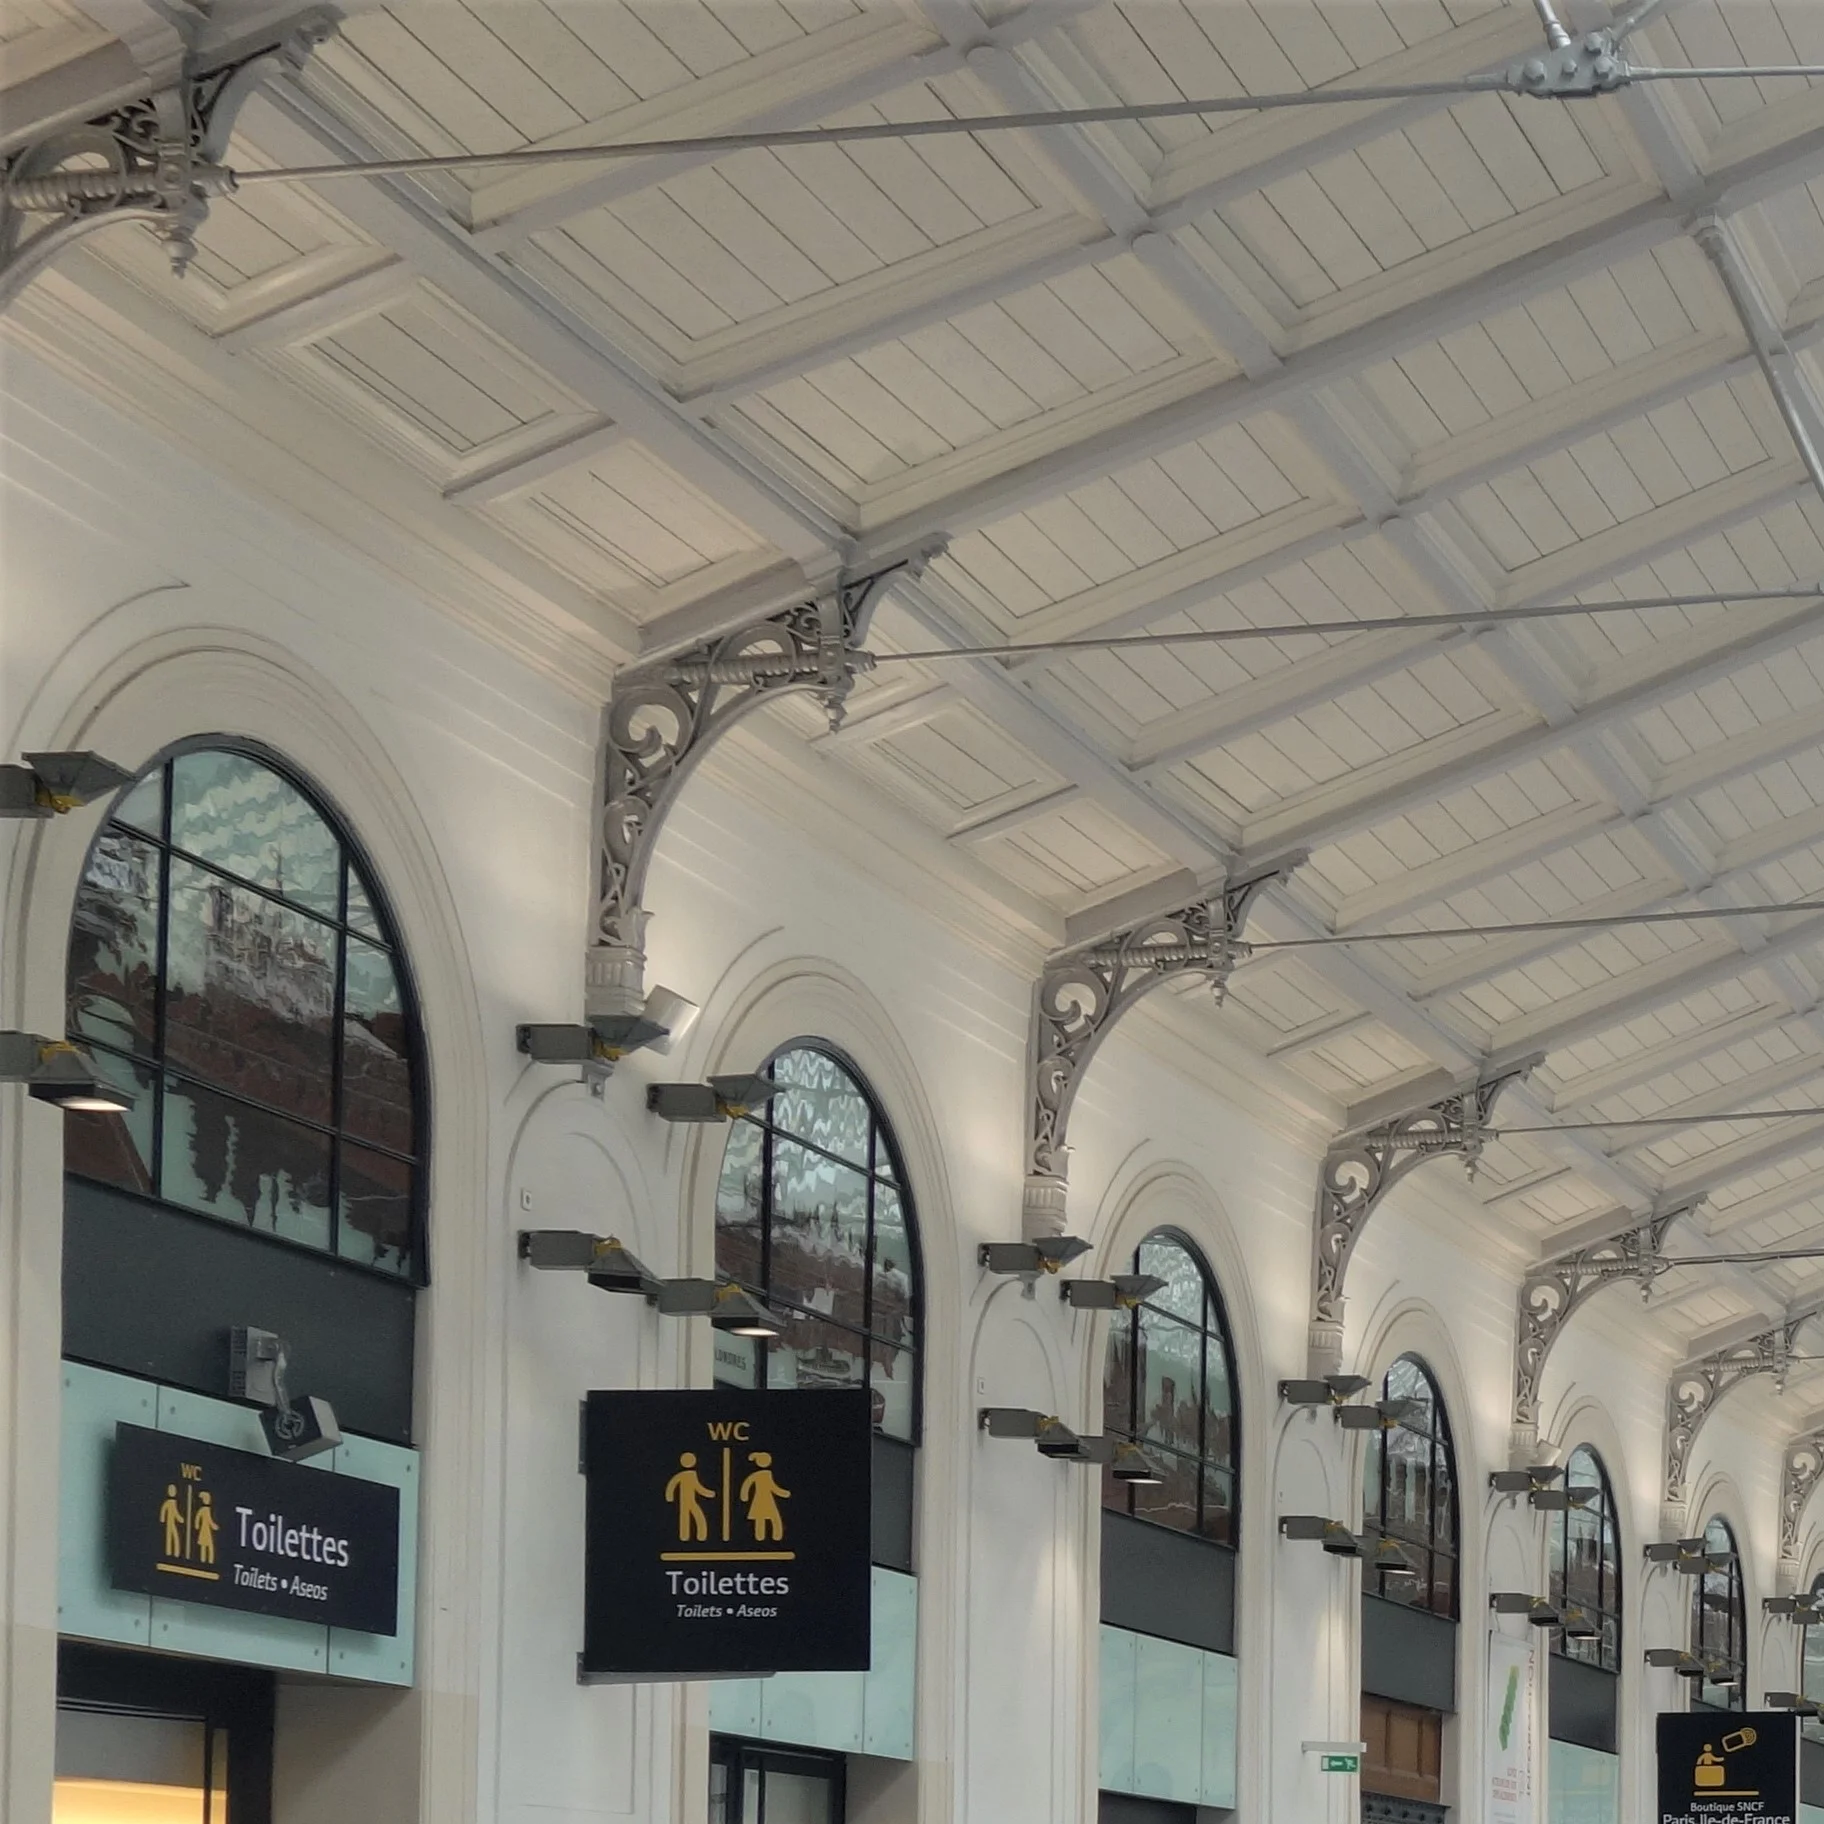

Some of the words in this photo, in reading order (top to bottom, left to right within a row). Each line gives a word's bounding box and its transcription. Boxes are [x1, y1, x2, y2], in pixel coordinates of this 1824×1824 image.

[707, 1421, 750, 1441] WC
[180, 1462, 202, 1482] WC
[235, 1506, 349, 1567] Toilettes
[233, 1563, 278, 1592] Toilets
[289, 1575, 328, 1601] Aseos
[665, 1570, 790, 1596] Toilettes
[676, 1604, 723, 1618] Toilets
[736, 1604, 778, 1618] Aseos
[1690, 1801, 1735, 1814] Boutique
[1737, 1801, 1765, 1812] SNCF
